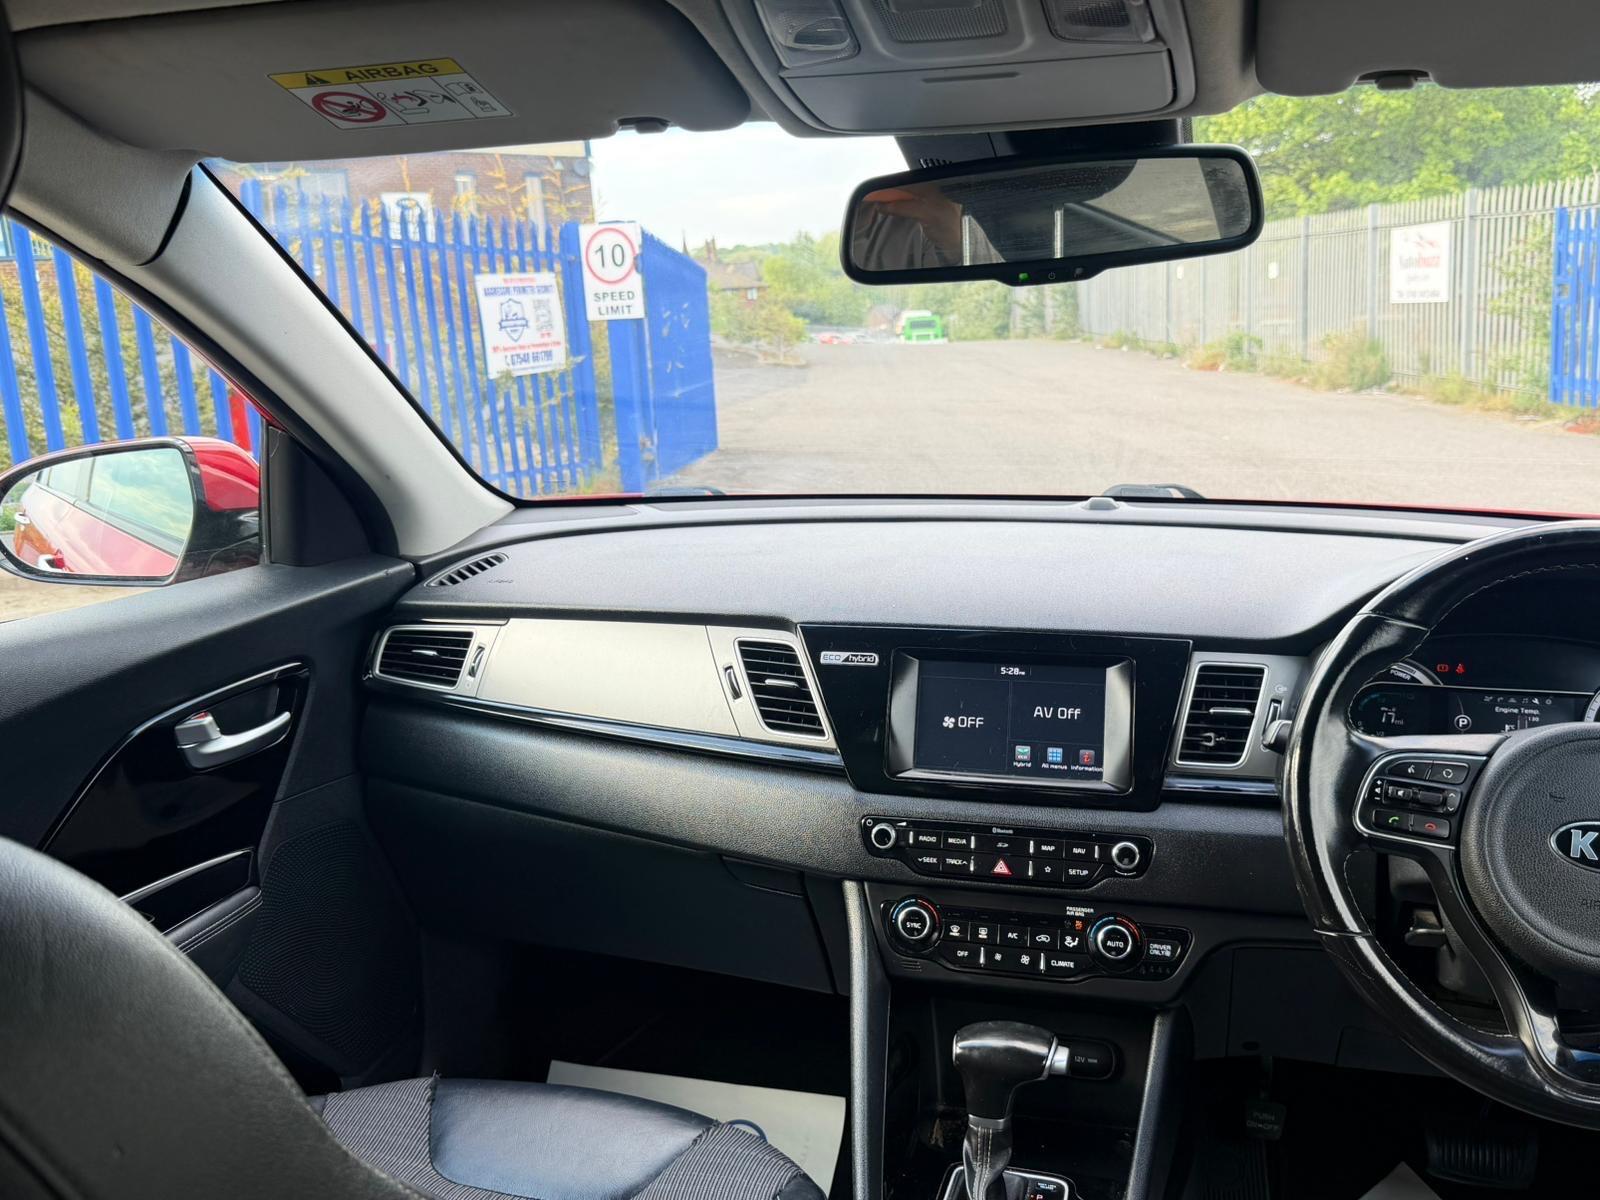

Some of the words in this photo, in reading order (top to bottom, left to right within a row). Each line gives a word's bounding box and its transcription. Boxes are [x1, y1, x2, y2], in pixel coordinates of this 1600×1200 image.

[345, 63, 439, 82] AIRBAG
[595, 244, 625, 269] 10
[593, 291, 635, 303] SPEED
[598, 305, 633, 316] LIMIT
[848, 654, 875, 663] hybrid
[1000, 667, 1019, 675] 5:28
[1389, 669, 1411, 681] POWER
[1033, 706, 1053, 719] AV
[1057, 707, 1081, 720] Off
[1494, 706, 1519, 714] Engine
[957, 716, 984, 729] OFF
[1458, 718, 1468, 728] P
[1068, 868, 1089, 876] SETUP
[906, 921, 922, 929] SYNC
[1106, 940, 1124, 948] AUTO
[1050, 960, 1075, 969] CLIMATE
[1074, 1055, 1085, 1063] 12V
